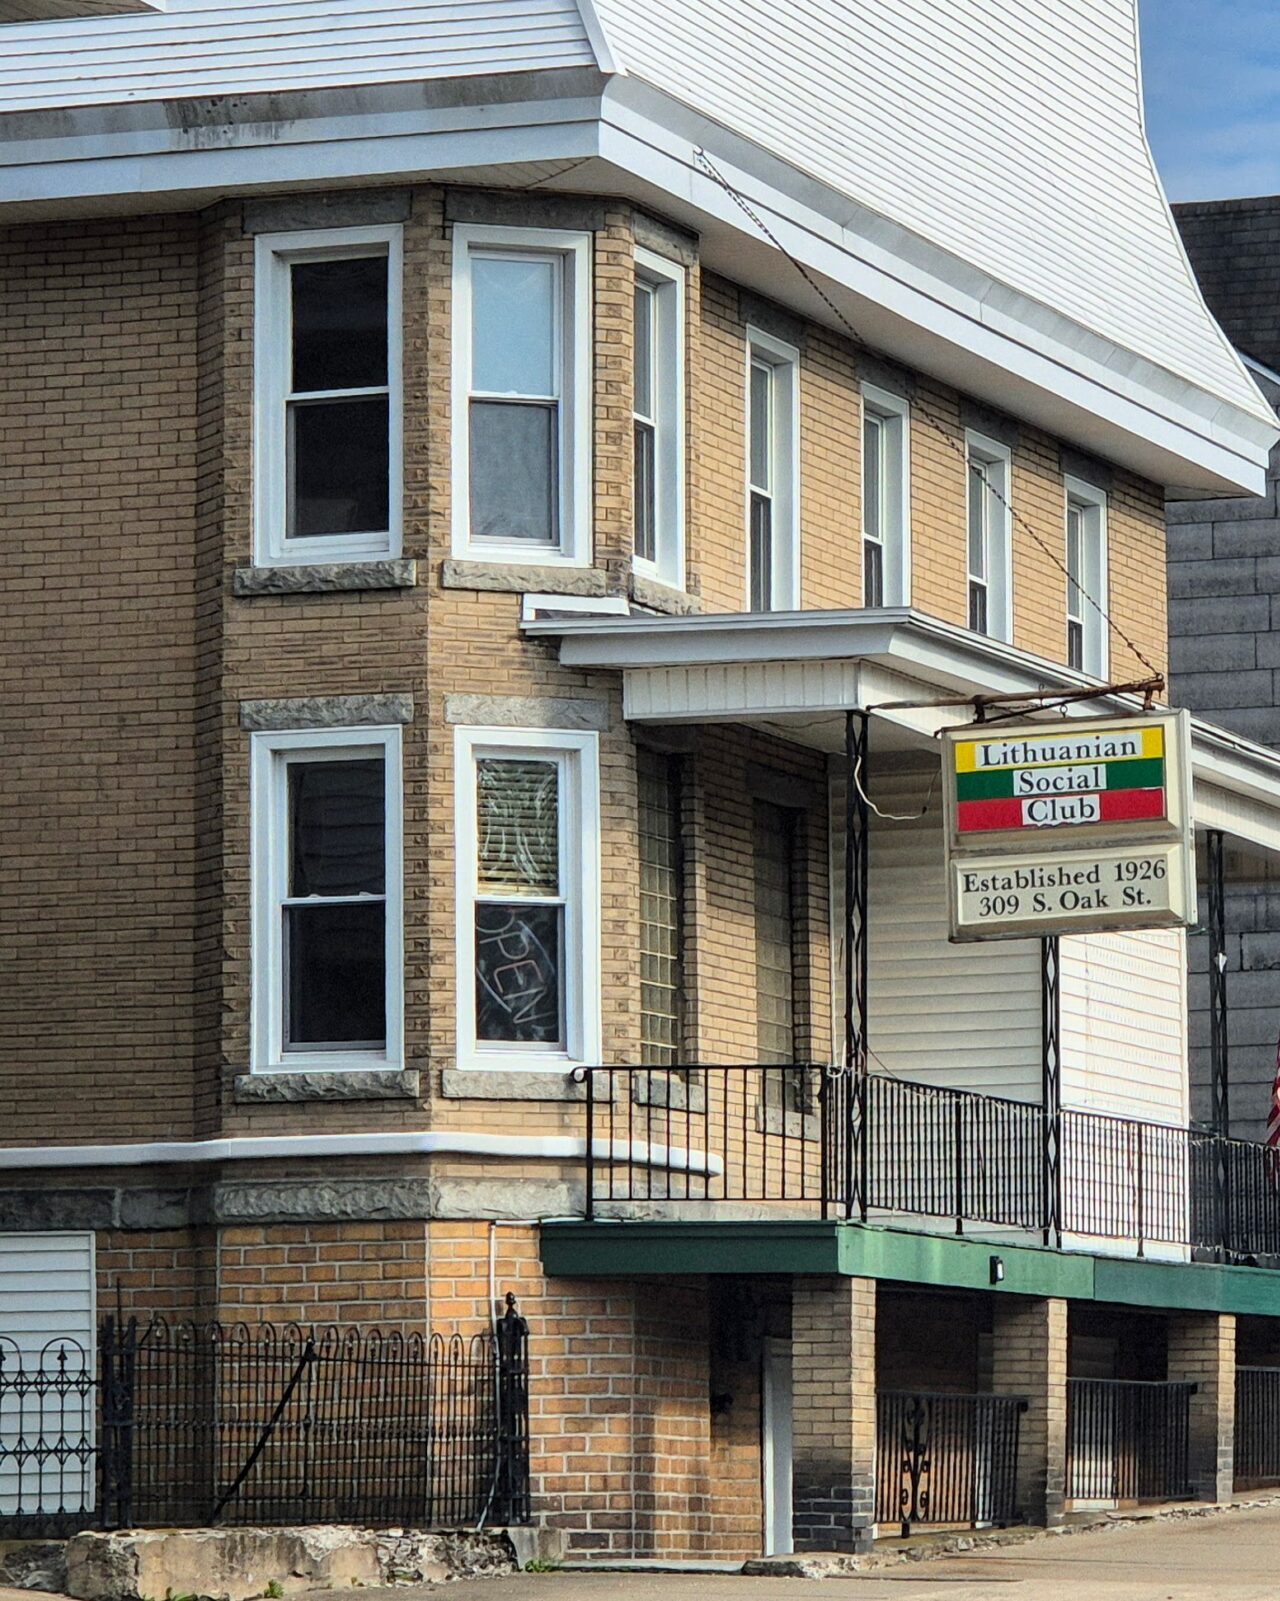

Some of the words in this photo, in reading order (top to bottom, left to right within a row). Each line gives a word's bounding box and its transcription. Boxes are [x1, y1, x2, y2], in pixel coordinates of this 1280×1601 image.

[980, 735, 1138, 767] Lithuanian
[1018, 766, 1102, 793] Social
[1027, 797, 1095, 822] Club
[963, 864, 1101, 893] Established
[1114, 859, 1166, 882] 1926
[979, 894, 1020, 917] 309
[1032, 893, 1052, 913] S.
[1060, 889, 1109, 911] Oak
[1122, 887, 1152, 906] St.
